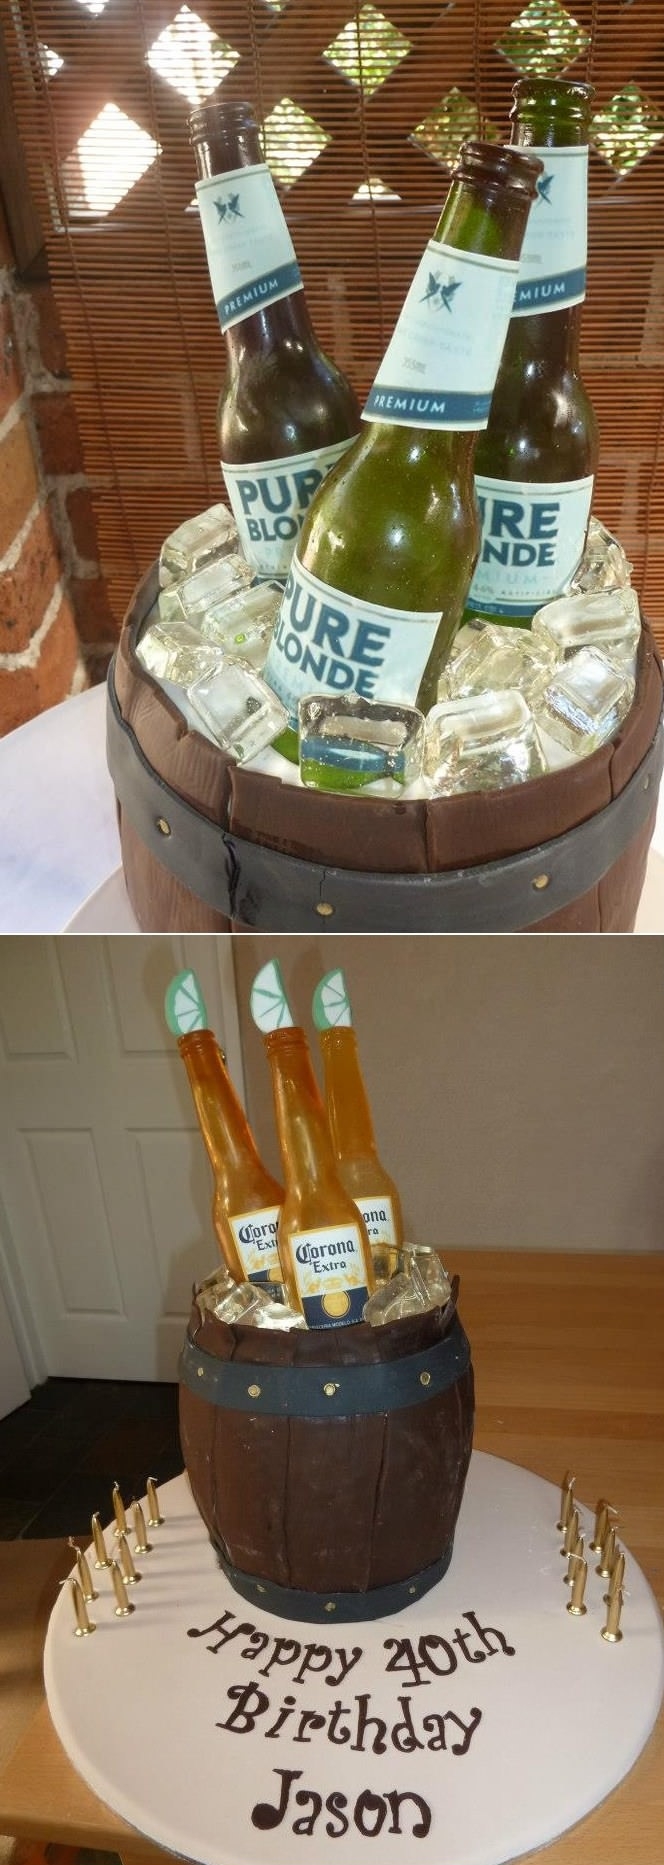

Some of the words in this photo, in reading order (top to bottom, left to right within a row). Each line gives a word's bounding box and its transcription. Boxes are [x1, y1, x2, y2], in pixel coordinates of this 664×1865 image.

[223, 279, 279, 316] PREMIUM
[513, 281, 567, 302] MIUM
[373, 394, 447, 414] PREMIUM
[235, 462, 335, 516] PUR
[244, 514, 305, 542] BLO
[295, 1239, 356, 1265] Corona
[310, 1260, 347, 1274] Extra
[186, 1610, 364, 1687] Happy
[383, 1611, 516, 1688] 40th
[215, 1681, 483, 1756] Birthday
[251, 1768, 432, 1838] Jason
